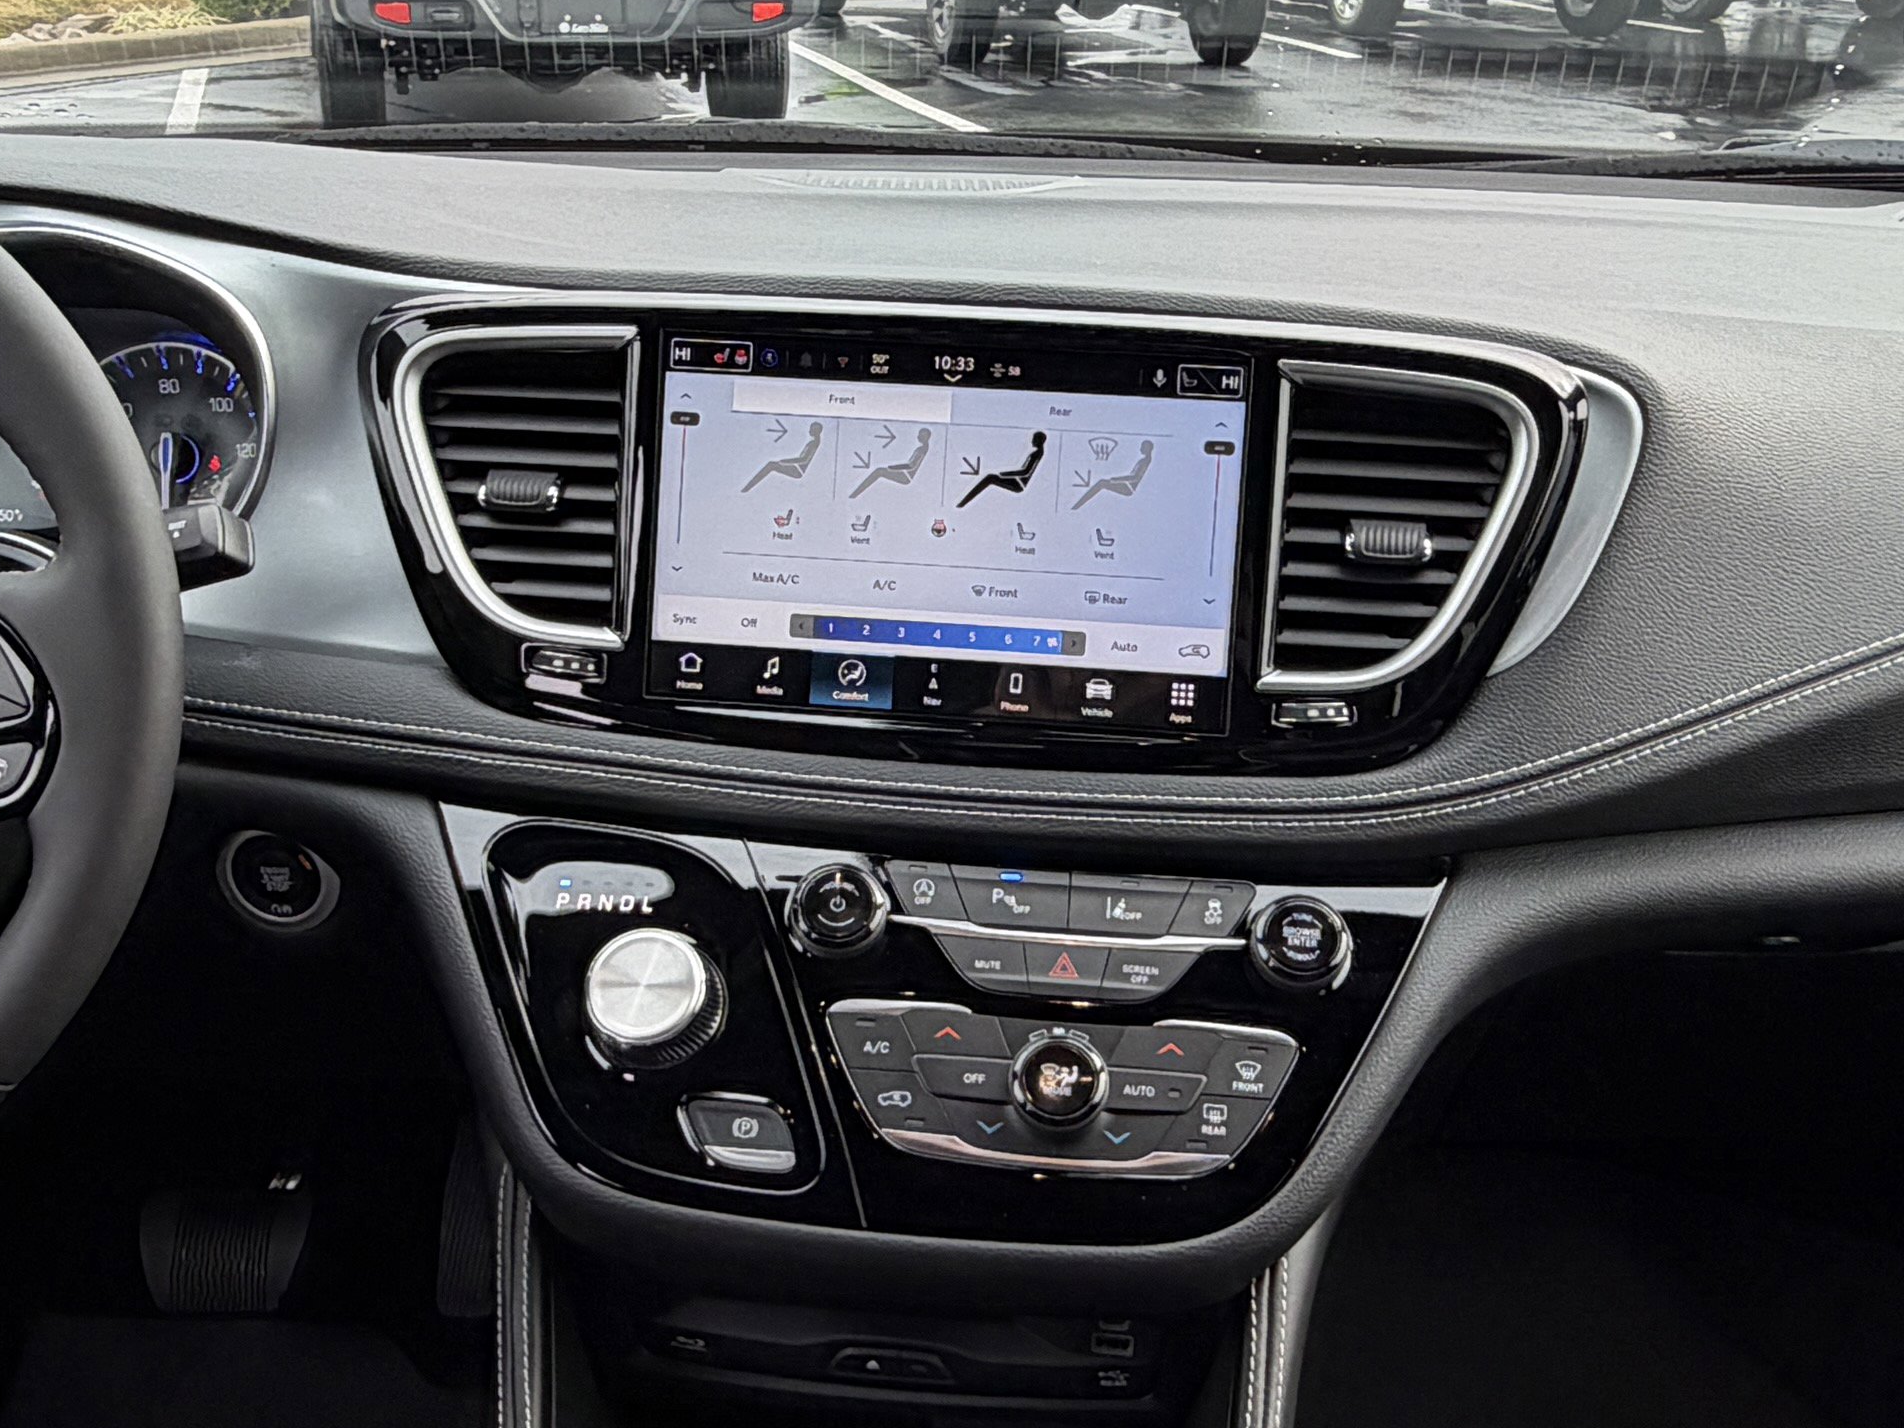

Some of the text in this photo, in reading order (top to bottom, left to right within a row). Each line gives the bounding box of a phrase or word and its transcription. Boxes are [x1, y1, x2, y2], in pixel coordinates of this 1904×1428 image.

[674, 347, 691, 361] HI
[933, 355, 975, 372] 10:33
[158, 378, 180, 394] 80
[1221, 375, 1239, 390] HI
[208, 397, 234, 413] 100
[828, 394, 856, 405] Front
[1049, 406, 1072, 417] Rear
[235, 442, 257, 458] 120
[752, 571, 800, 586] Max A/C
[872, 579, 897, 592] A/C
[988, 586, 1018, 599] Front
[1102, 593, 1128, 605] Rear
[672, 612, 697, 625] Sync
[740, 617, 758, 628] Off
[1110, 640, 1138, 653] Auto
[676, 679, 704, 691] Home
[756, 684, 784, 696] Media
[832, 690, 869, 703] Comfort
[922, 696, 942, 707] Nav
[1000, 701, 1029, 713] Phone
[1080, 705, 1114, 719] Vehicle
[1169, 712, 1193, 724] Apps
[974, 958, 1001, 970] MUTE
[1122, 963, 1159, 976] SCREEN
[1130, 974, 1149, 984] OFF
[863, 1040, 890, 1054] A/C
[962, 1072, 987, 1085] OFF
[1122, 1083, 1156, 1098] AUTO
[1232, 1080, 1264, 1094] FRONT
[1201, 1124, 1227, 1137] REAR
